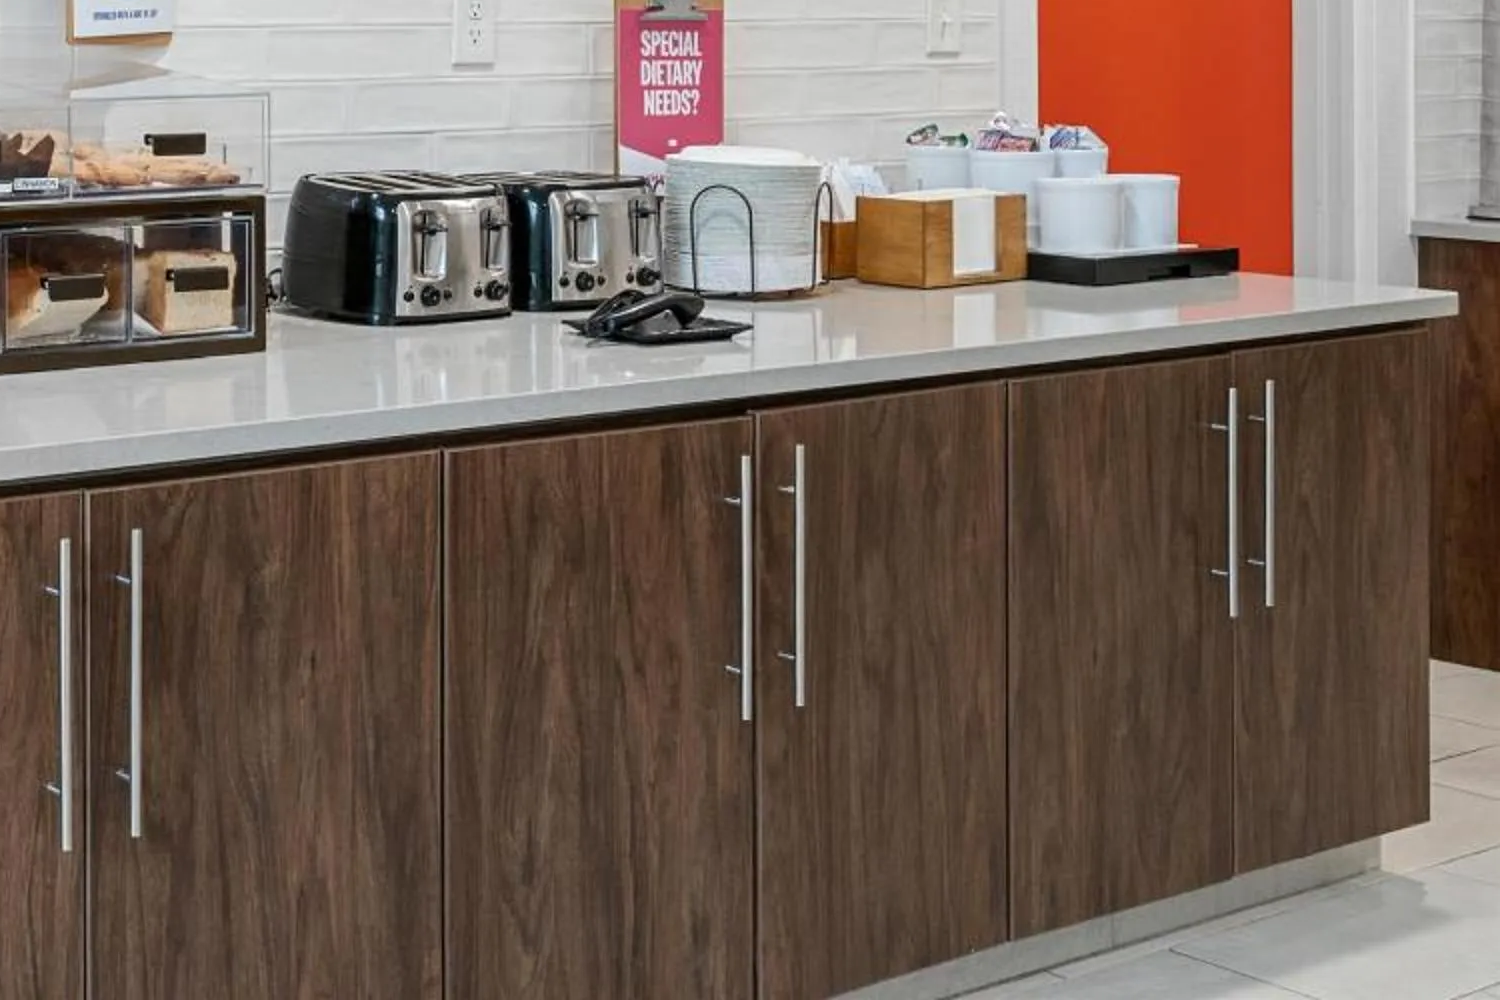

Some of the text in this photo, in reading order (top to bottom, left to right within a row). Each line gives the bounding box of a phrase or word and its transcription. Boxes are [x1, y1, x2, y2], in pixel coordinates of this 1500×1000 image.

[640, 30, 702, 57] SPECIAL
[640, 59, 703, 87] DIETARY
[643, 89, 700, 117] NEEDS?
